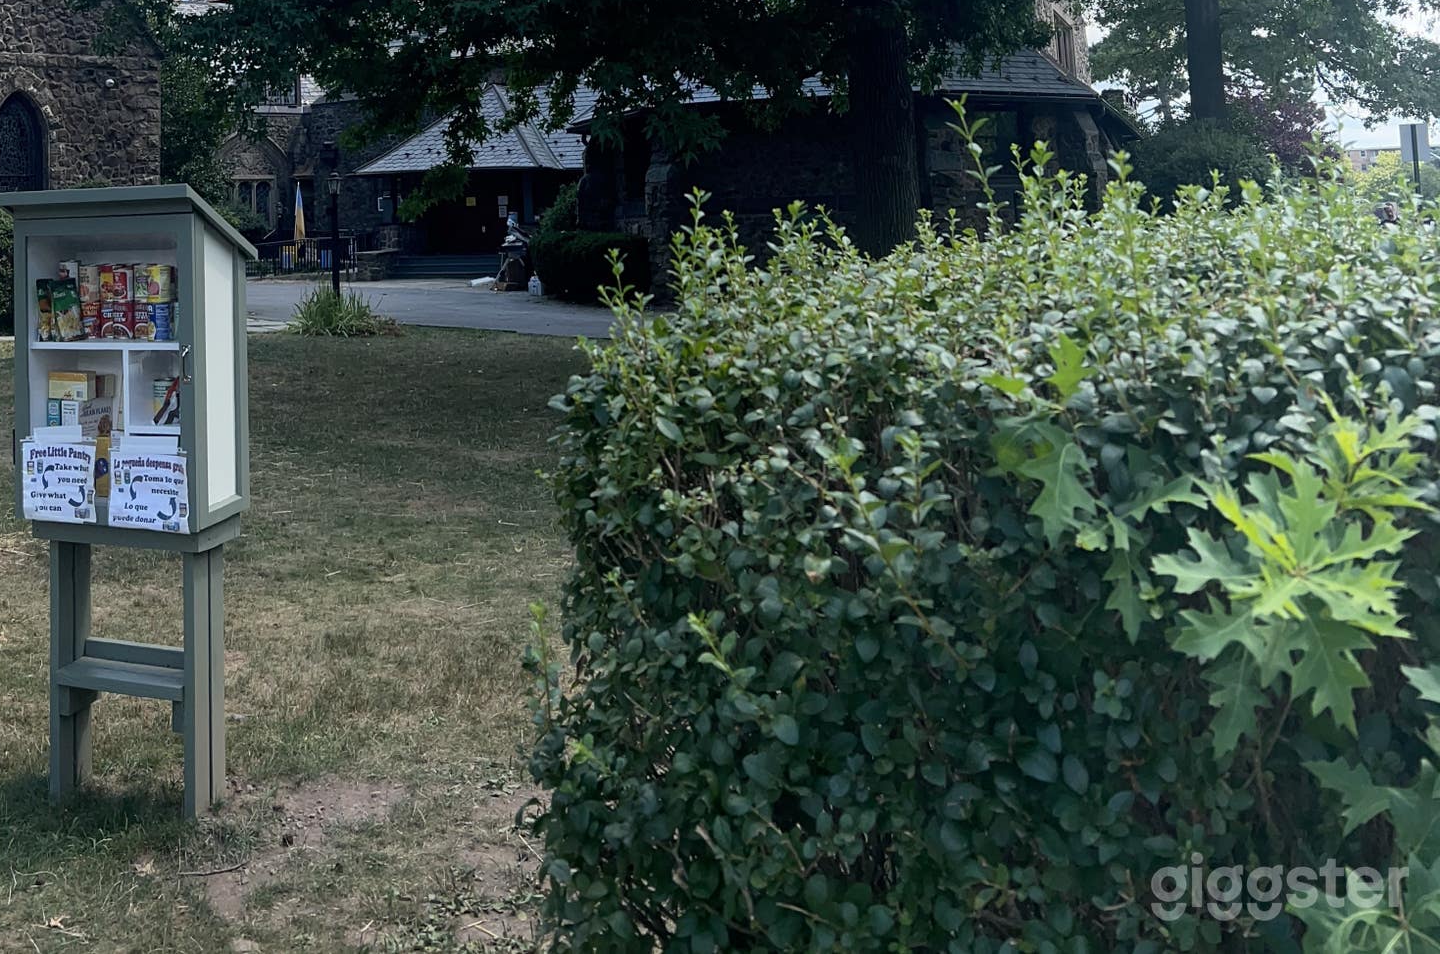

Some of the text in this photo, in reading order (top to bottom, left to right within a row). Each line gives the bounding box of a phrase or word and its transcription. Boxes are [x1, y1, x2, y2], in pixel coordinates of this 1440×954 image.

[30, 446, 91, 465] Free Little Pantry
[54, 463, 89, 472] Take what
[144, 474, 164, 483] Toma
[173, 478, 185, 486] que
[30, 490, 47, 499] Give
[124, 502, 148, 512] Lo que
[134, 515, 157, 524] donar
